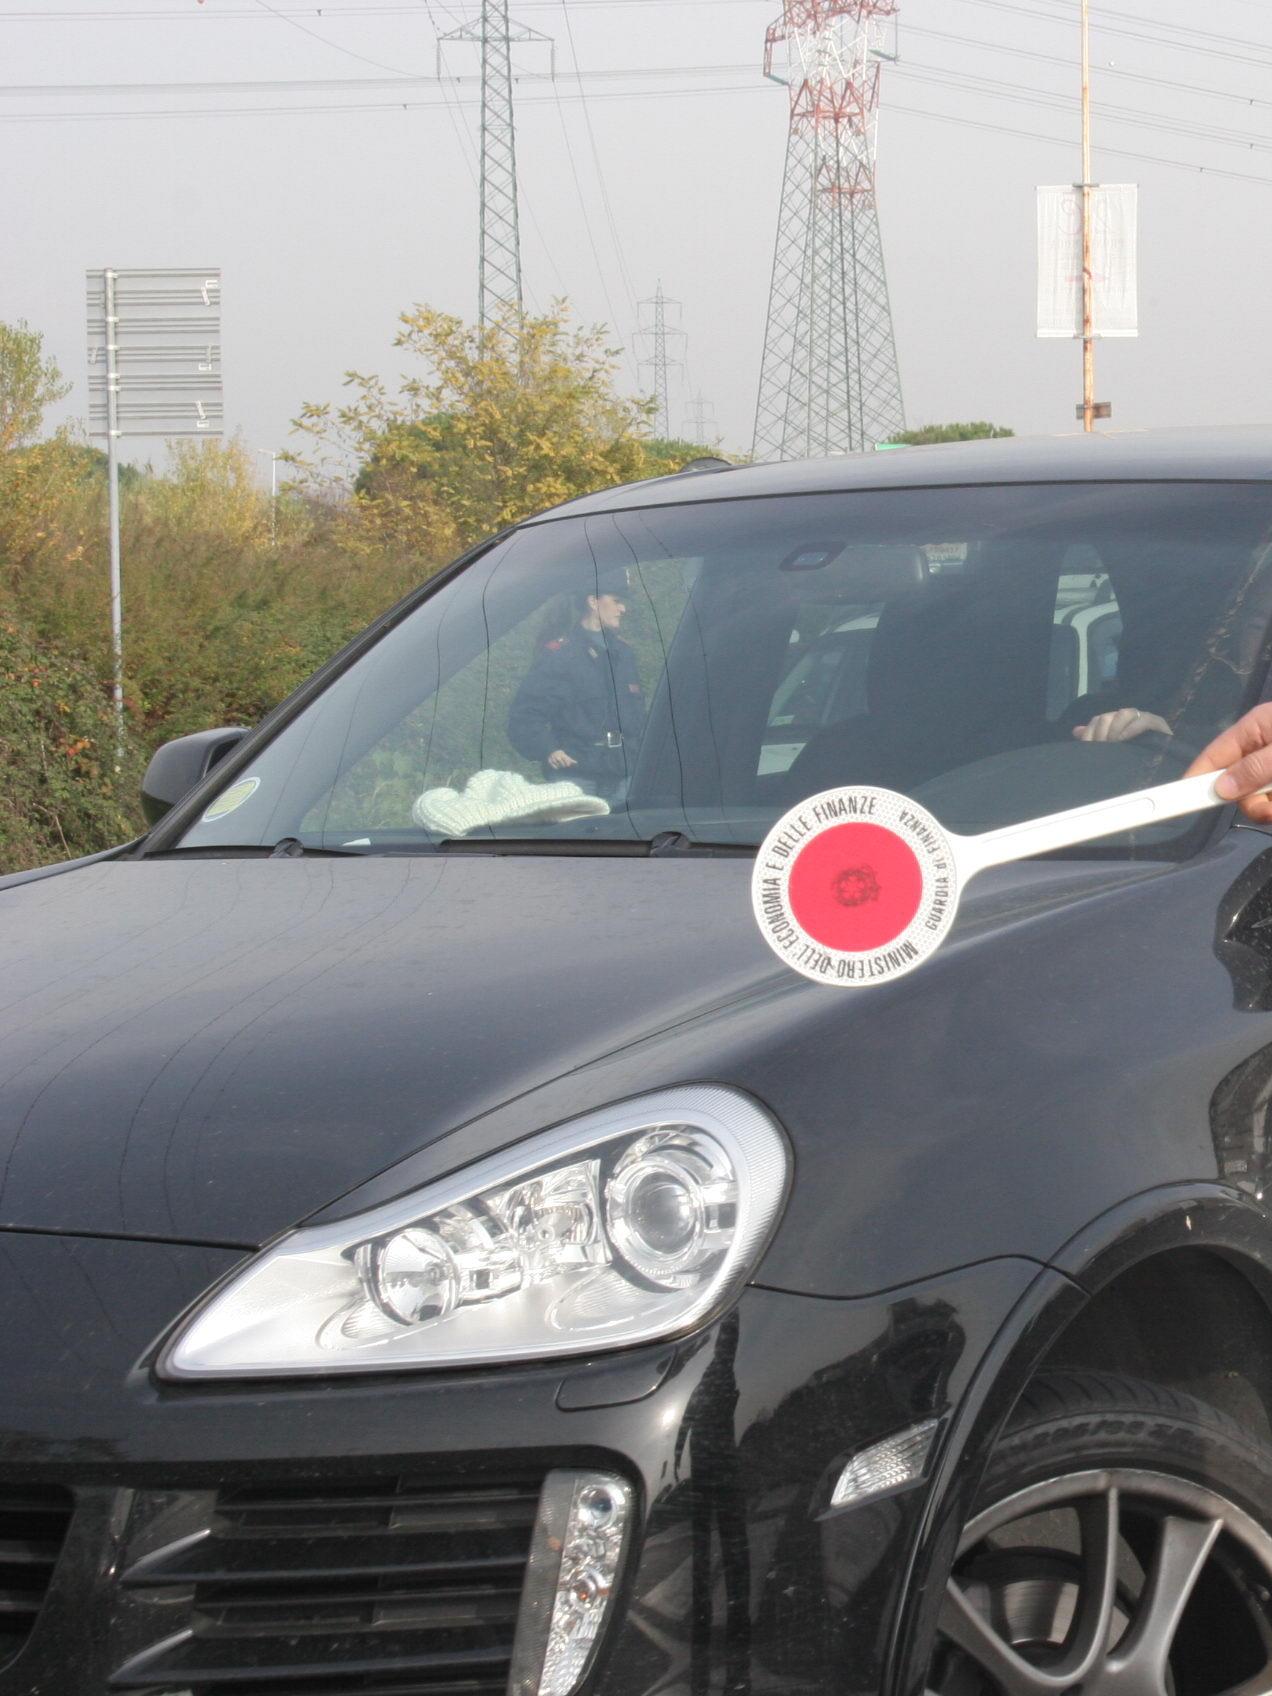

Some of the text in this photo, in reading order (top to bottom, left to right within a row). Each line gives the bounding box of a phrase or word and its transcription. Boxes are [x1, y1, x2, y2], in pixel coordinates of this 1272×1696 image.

[813, 796, 877, 824] FINANZE
[774, 815, 810, 857] DELLE
[899, 809, 939, 854] FINANZA
[766, 863, 783, 871] E
[925, 876, 949, 931] GUARDIA
[837, 940, 920, 979] MINISTERO
